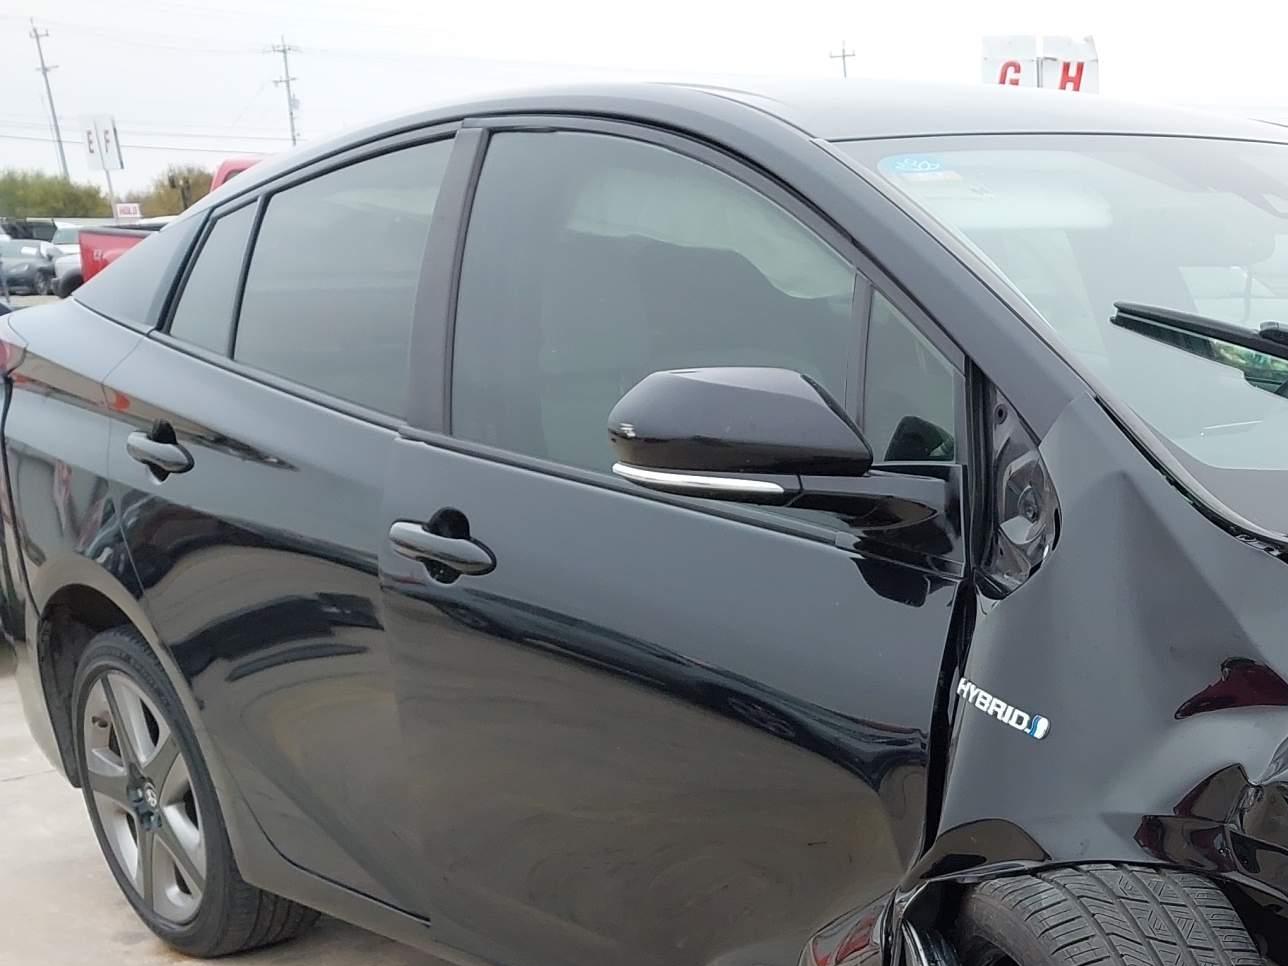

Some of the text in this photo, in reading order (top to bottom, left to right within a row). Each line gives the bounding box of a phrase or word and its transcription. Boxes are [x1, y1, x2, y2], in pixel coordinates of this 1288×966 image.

[998, 60, 1021, 86] G
[1058, 61, 1085, 92] H
[956, 677, 1031, 731] HYBRID
